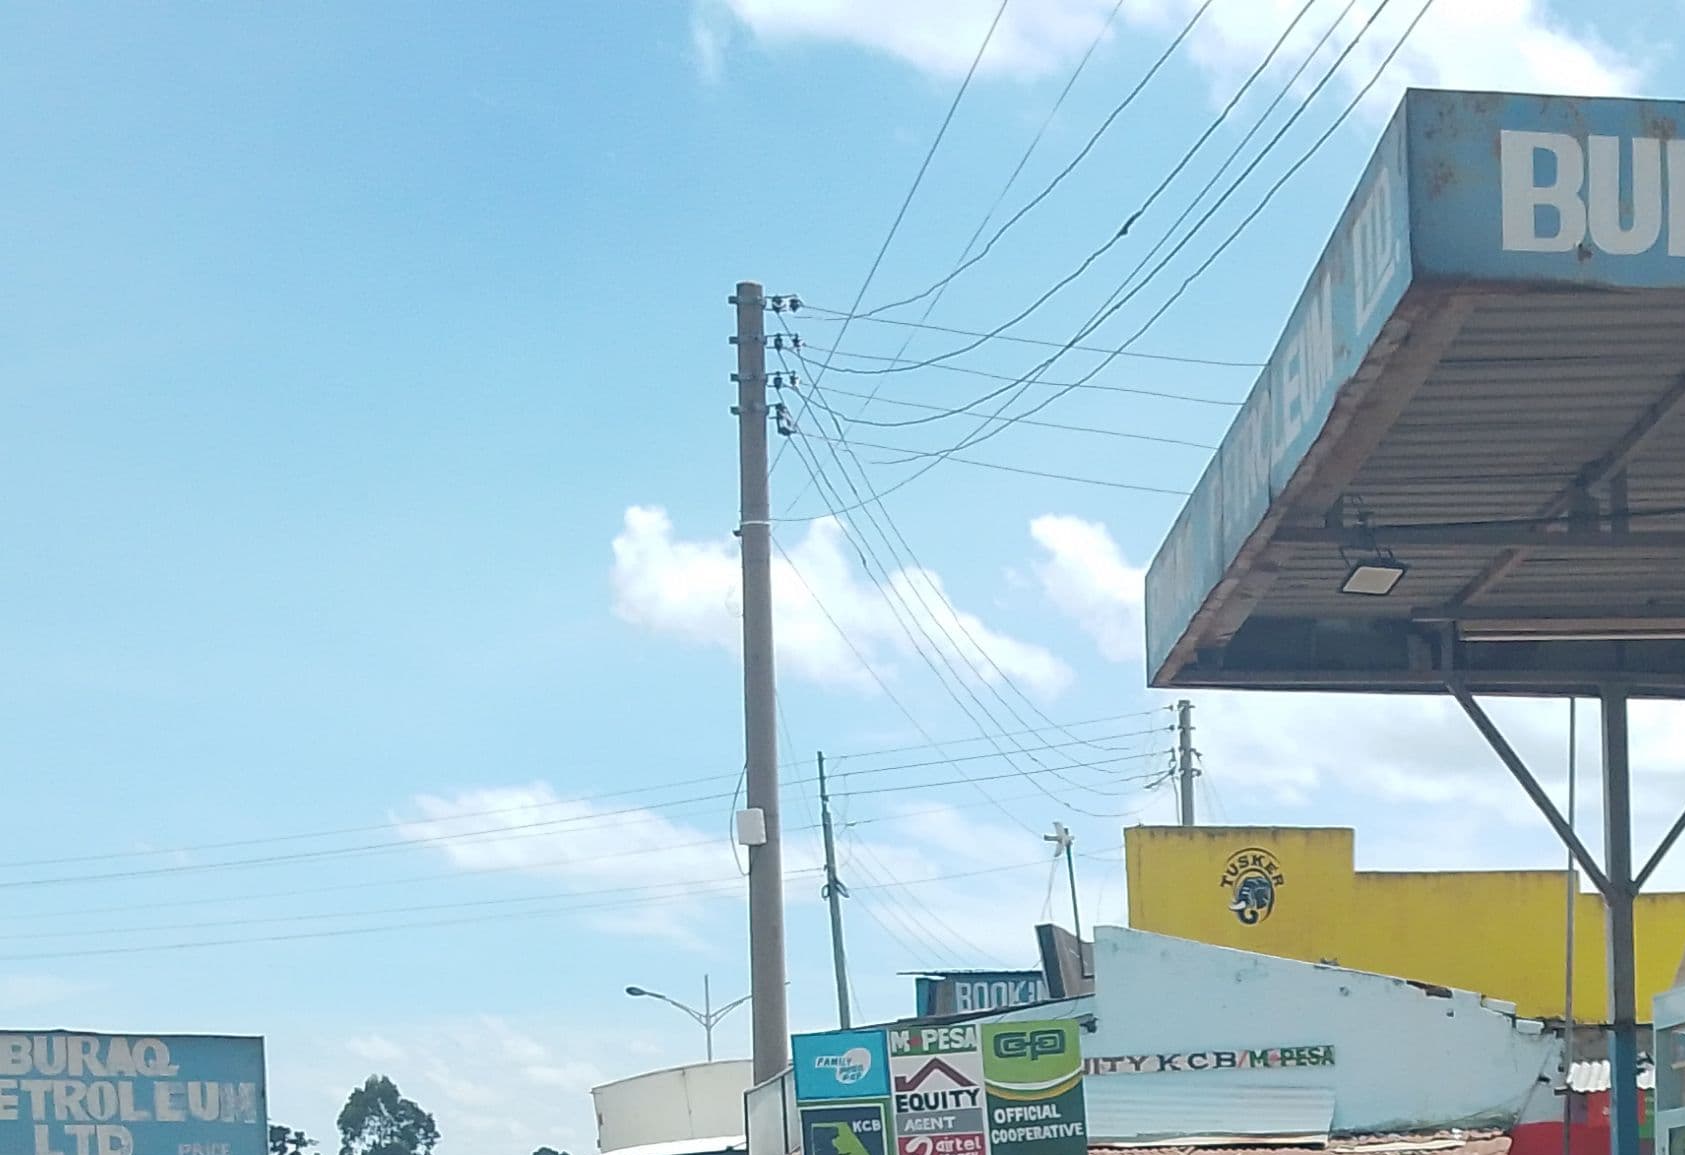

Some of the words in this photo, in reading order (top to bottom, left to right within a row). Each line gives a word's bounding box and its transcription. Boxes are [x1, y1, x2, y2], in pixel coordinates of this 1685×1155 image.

[1220, 854, 1284, 888] TUSKER
[955, 980, 1050, 1013] BOOKIN
[0, 1036, 180, 1077] BURAQ
[0, 1078, 257, 1124] ETROLEUM
[896, 1088, 980, 1113] EQUITY
[852, 1119, 881, 1133] KCB
[904, 1116, 956, 1132] AGENT
[994, 1103, 1061, 1125] OFFICIAL
[936, 1135, 981, 1152] airtel
[991, 1122, 1084, 1145] COOPERATIVE
